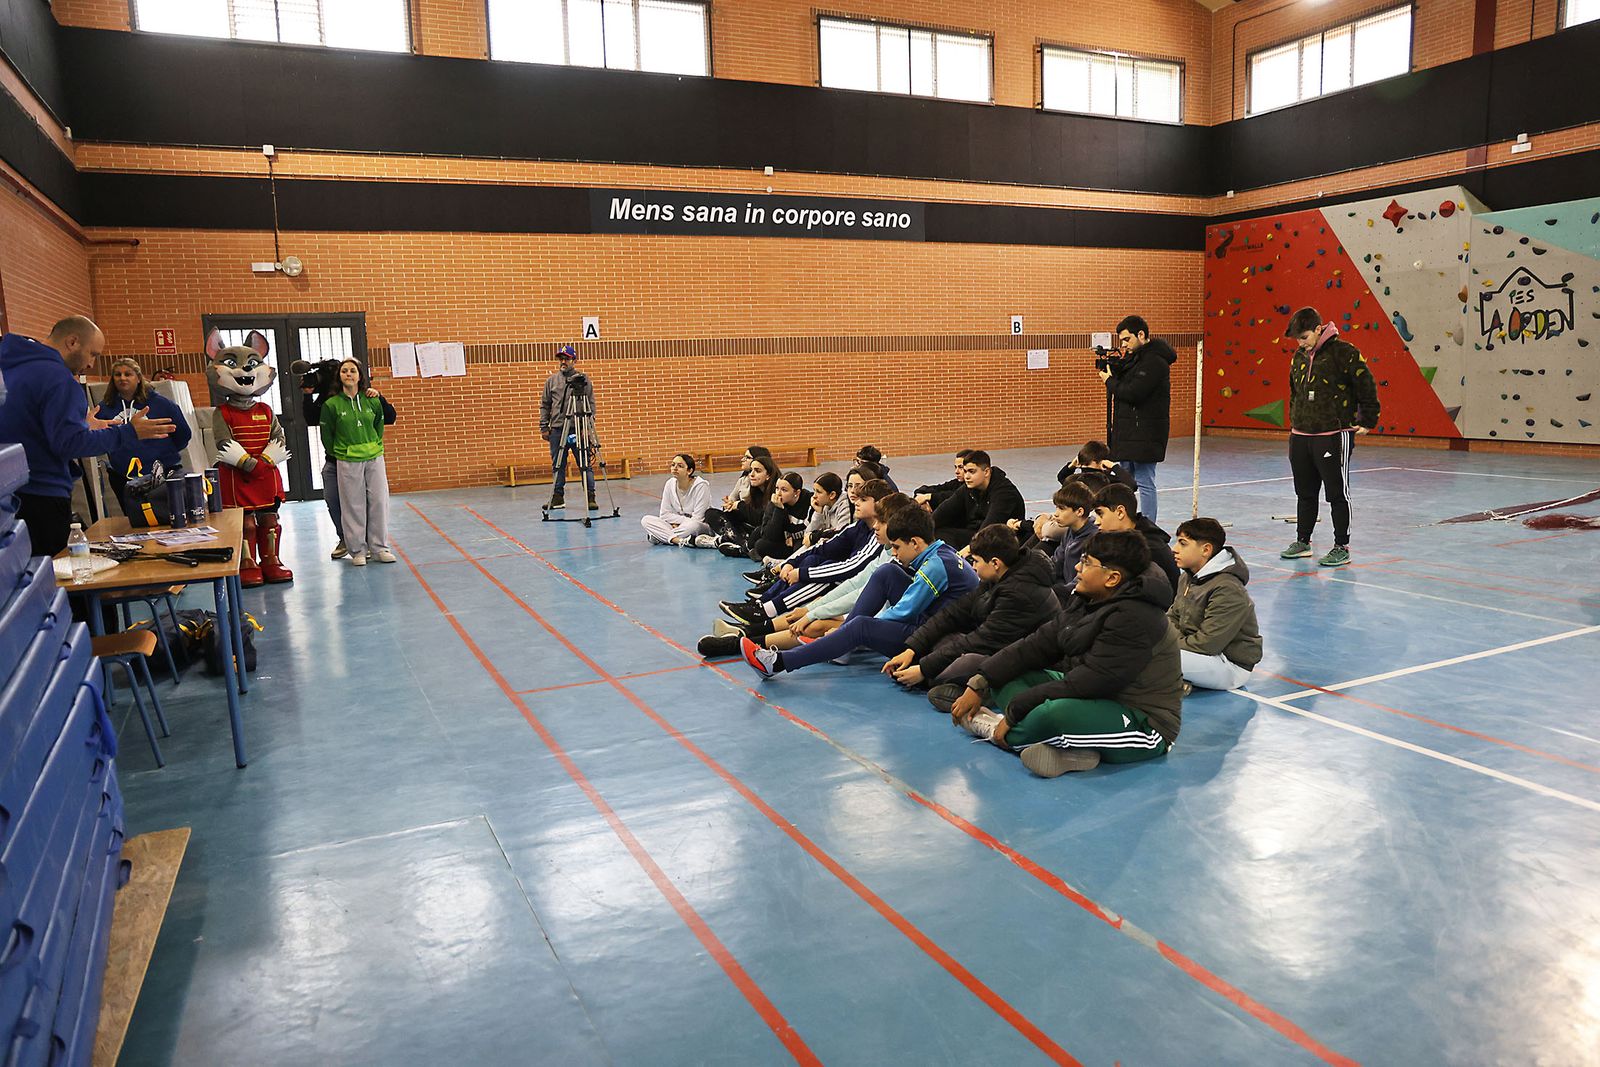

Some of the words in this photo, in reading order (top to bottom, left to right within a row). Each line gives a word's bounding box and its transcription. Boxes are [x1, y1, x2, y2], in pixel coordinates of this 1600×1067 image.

[609, 198, 675, 221] Mens
[681, 204, 738, 223] sana
[744, 202, 765, 224] in
[772, 208, 856, 230] corpore
[861, 211, 911, 229] sano
[1509, 289, 1535, 305] IES
[585, 323, 598, 338] A
[1013, 321, 1021, 333] B
